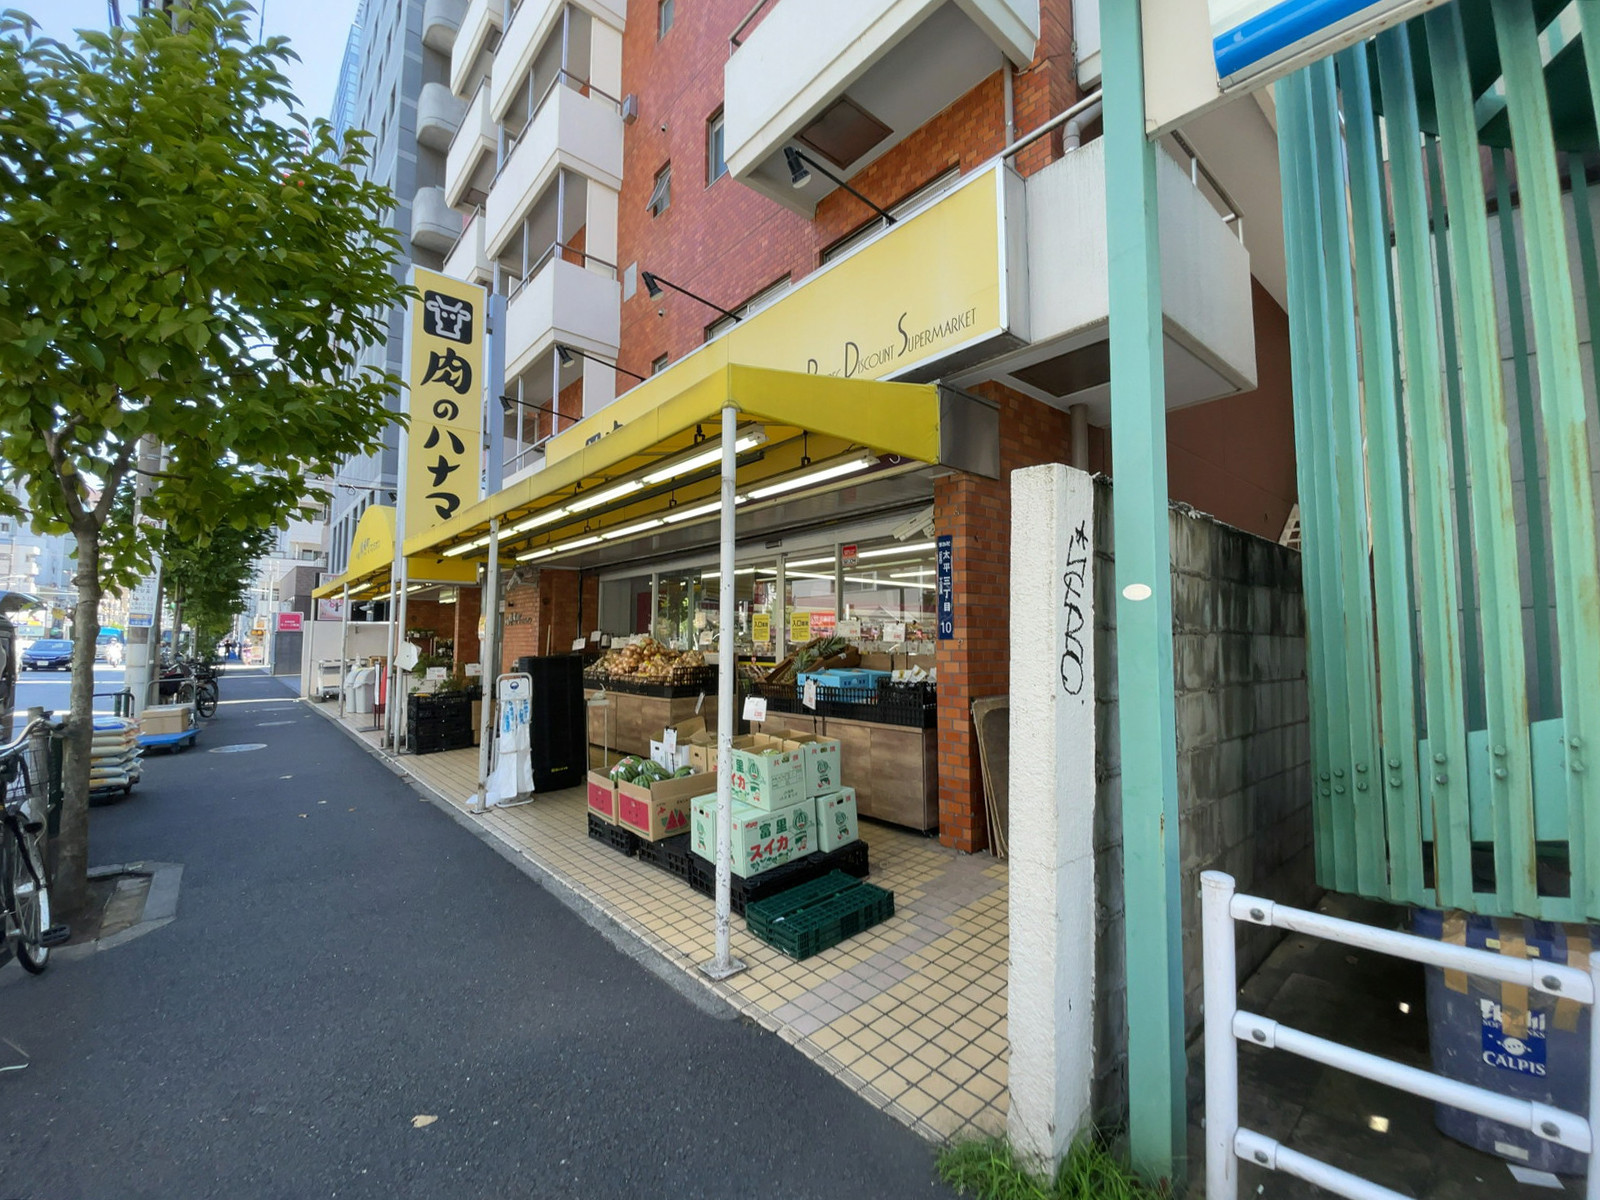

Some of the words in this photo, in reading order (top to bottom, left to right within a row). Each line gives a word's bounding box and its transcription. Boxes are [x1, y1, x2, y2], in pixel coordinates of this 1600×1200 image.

[844, 341, 895, 378] DISCOUNT
[897, 307, 977, 357] SUPERMARKET
[420, 347, 473, 524] 肉のハナマ
[942, 550, 951, 612] 太平三丁目
[940, 621, 952, 634] 10
[759, 818, 787, 839] 富里
[750, 835, 789, 862] スイカ
[1480, 998, 1546, 1031] Ashi
[1482, 1050, 1546, 1076] CALPIS
